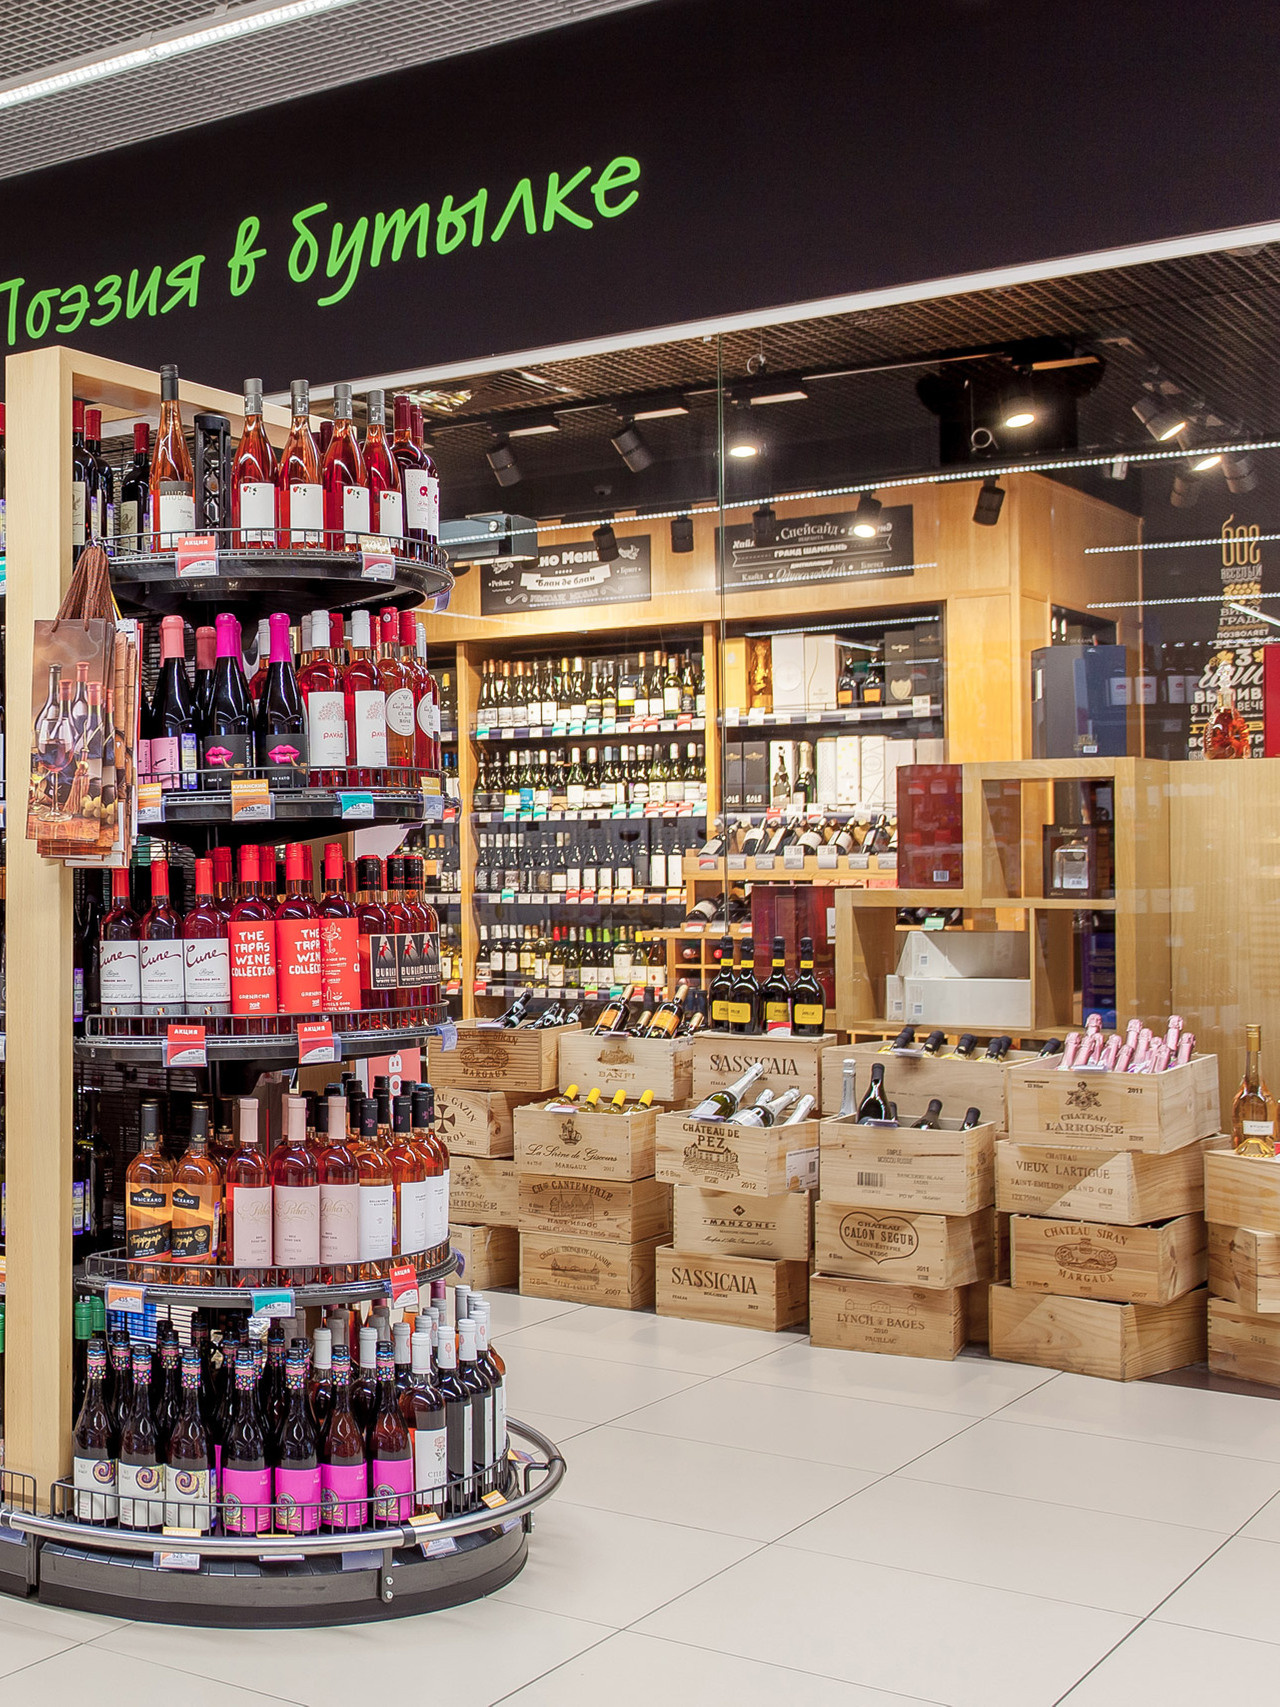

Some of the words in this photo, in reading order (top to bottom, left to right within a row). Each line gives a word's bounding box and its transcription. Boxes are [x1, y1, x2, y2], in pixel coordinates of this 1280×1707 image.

[229, 215, 267, 298] в
[288, 155, 643, 307] бутылке
[781, 521, 839, 541] Спейсайд
[1235, 648, 1253, 666] 3
[239, 931, 265, 942] THE
[234, 942, 270, 954] TAPAS
[186, 944, 228, 969] Cune
[236, 953, 271, 966] WINE
[231, 965, 275, 978] COLLECTION
[303, 1025, 326, 1033] АКЦИЯ
[710, 1053, 799, 1076] SASSICAIA
[461, 1067, 508, 1078] MARGAUX
[598, 1070, 636, 1080] BANFI
[451, 1096, 477, 1123] GAZIN
[1060, 1112, 1108, 1122] CHATEAU
[727, 1129, 740, 1139] DE
[697, 1135, 726, 1149] PEZ
[571, 1149, 581, 1160] de
[555, 1162, 587, 1170] MARGAUX
[1015, 1160, 1049, 1174] VIEUX
[1055, 1165, 1110, 1179] LARTIGUE
[550, 1180, 614, 1202] CANTEMERLE
[741, 1181, 757, 1190] 2012
[1068, 1184, 1094, 1193] GRAND
[1097, 1186, 1114, 1196] CRU
[709, 1219, 770, 1229] MANZONE
[857, 1221, 901, 1231] CHATEAU
[844, 1226, 876, 1241] CALON
[881, 1229, 915, 1246] SEGUR
[1043, 1226, 1090, 1239] CHATEAU
[1096, 1229, 1129, 1246] SIRAN
[916, 1265, 930, 1273] 2011
[672, 1266, 759, 1295] SASSICAIA
[1057, 1268, 1116, 1284] MARGAUX
[605, 1288, 622, 1296] 2007
[837, 1312, 874, 1327] LYNCH
[886, 1316, 926, 1330] BAGES
